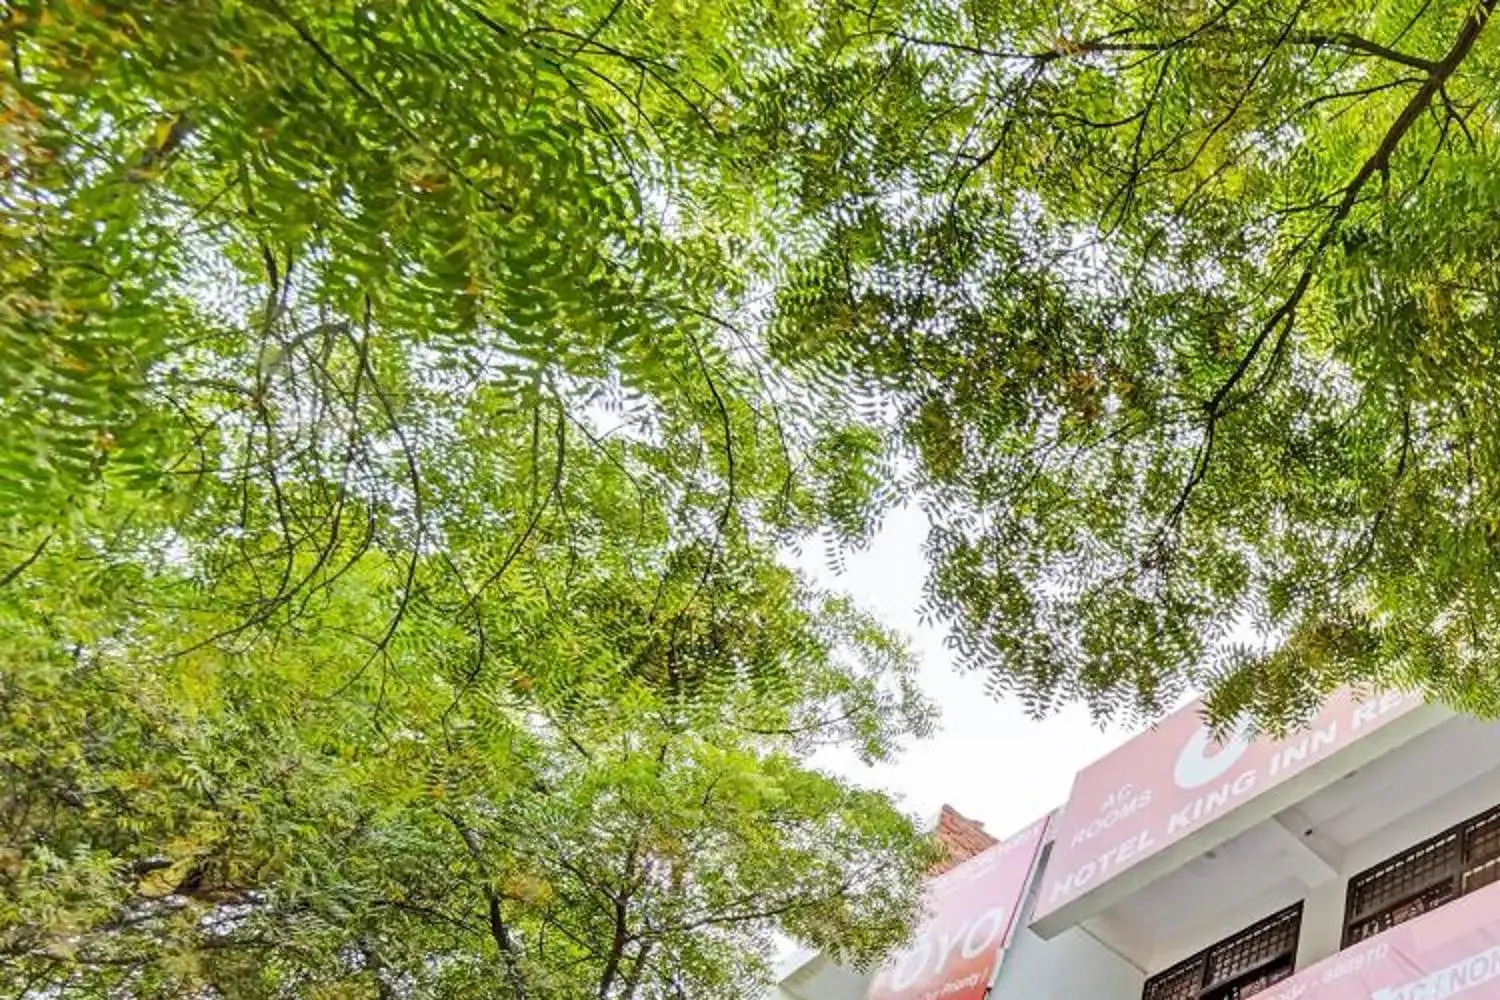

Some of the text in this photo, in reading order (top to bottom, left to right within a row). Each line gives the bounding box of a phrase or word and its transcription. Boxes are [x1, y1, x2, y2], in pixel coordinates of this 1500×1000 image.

[1049, 828, 1157, 901] HOTEL
[1166, 770, 1259, 834] KING
[1269, 723, 1338, 777] INN
[1070, 789, 1153, 849] ROOMS
